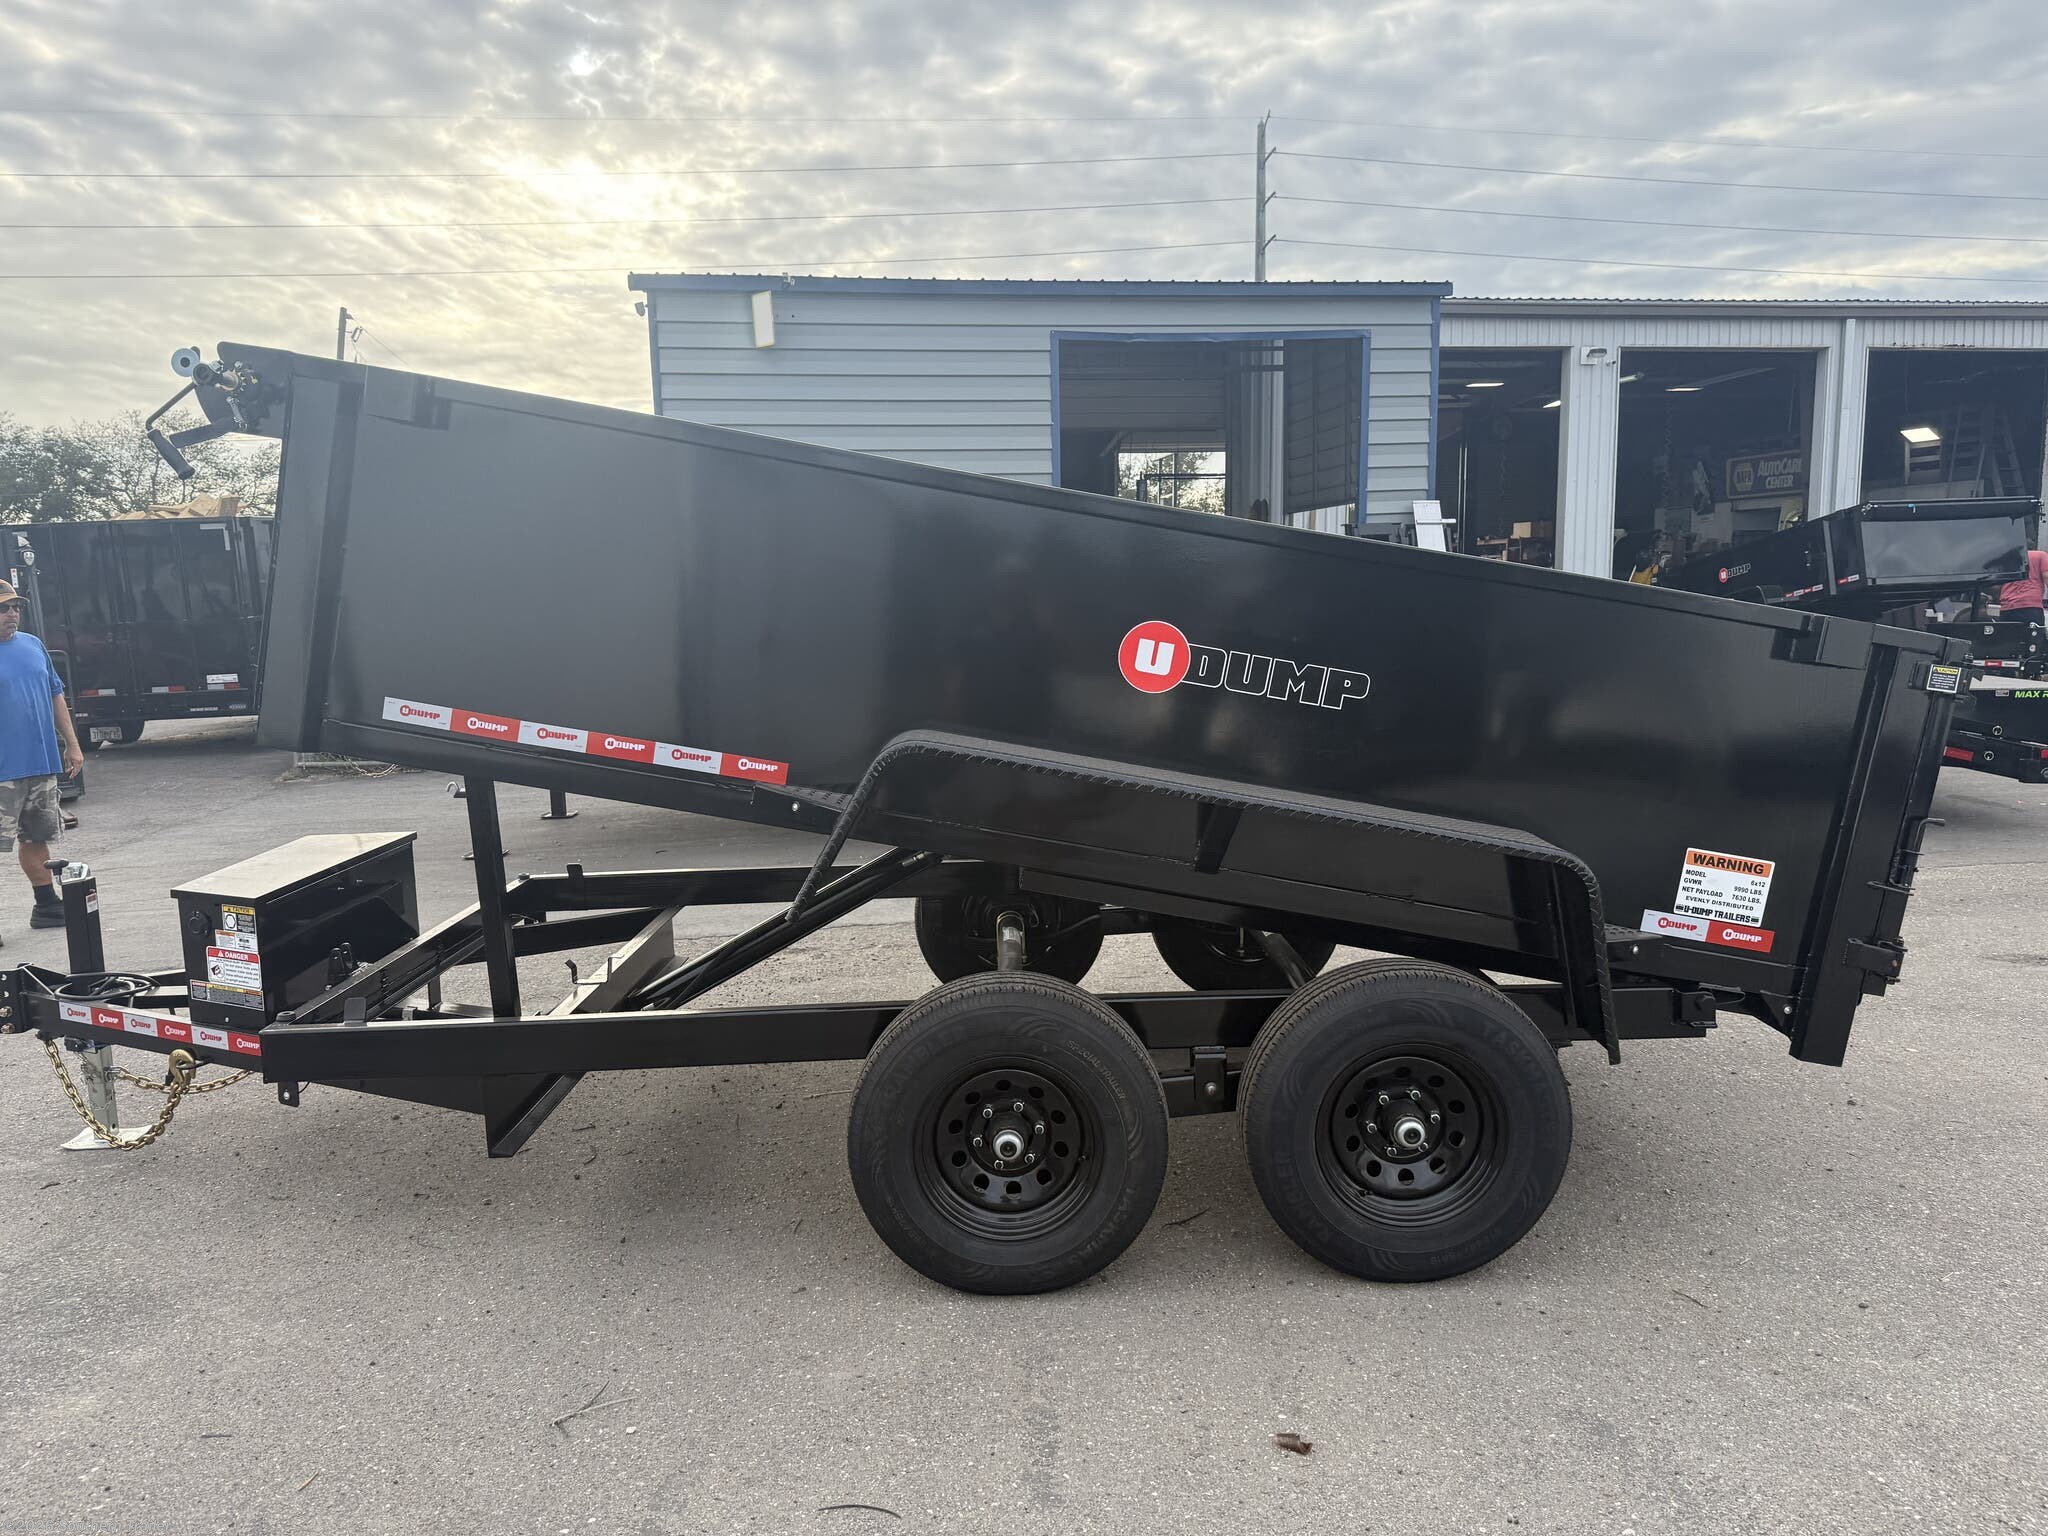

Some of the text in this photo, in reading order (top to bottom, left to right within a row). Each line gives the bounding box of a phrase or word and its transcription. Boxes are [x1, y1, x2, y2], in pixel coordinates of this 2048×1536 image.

[1766, 474, 1794, 489] CENTER
[2015, 690, 2040, 698] MAX
[1693, 853, 1764, 875] WARNING
[1685, 869, 1707, 878] MODEL
[1683, 877, 1702, 886] GVWR
[1695, 888, 1723, 898] PAYLOAD
[1685, 895, 1754, 911] EVENLY DISTRIBUTED
[1683, 905, 1751, 923] U-DUMP TRAILERS
[224, 951, 249, 961] DANGER
